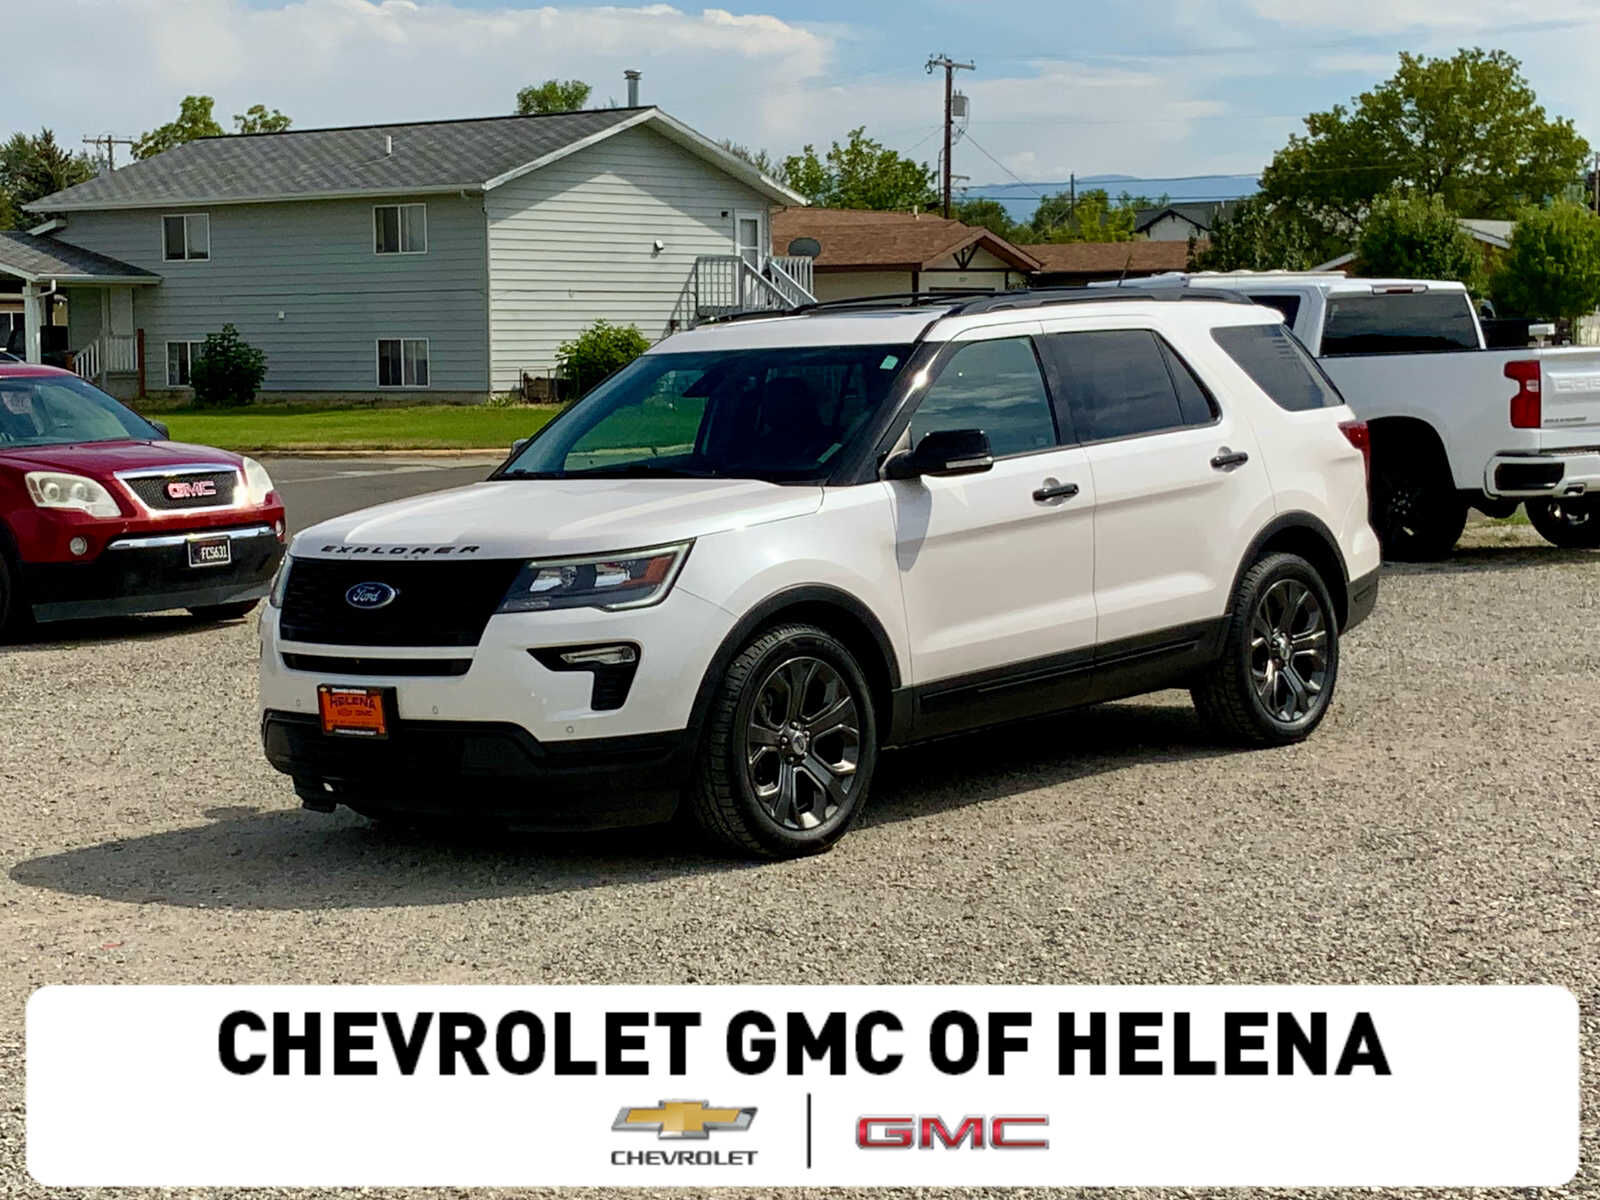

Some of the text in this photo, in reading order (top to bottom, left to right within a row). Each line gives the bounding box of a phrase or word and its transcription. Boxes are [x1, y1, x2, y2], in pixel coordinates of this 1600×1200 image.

[168, 481, 217, 498] GMC
[320, 545, 480, 555] EXPLORER
[352, 586, 382, 602] Ford
[330, 695, 377, 710] HELENA
